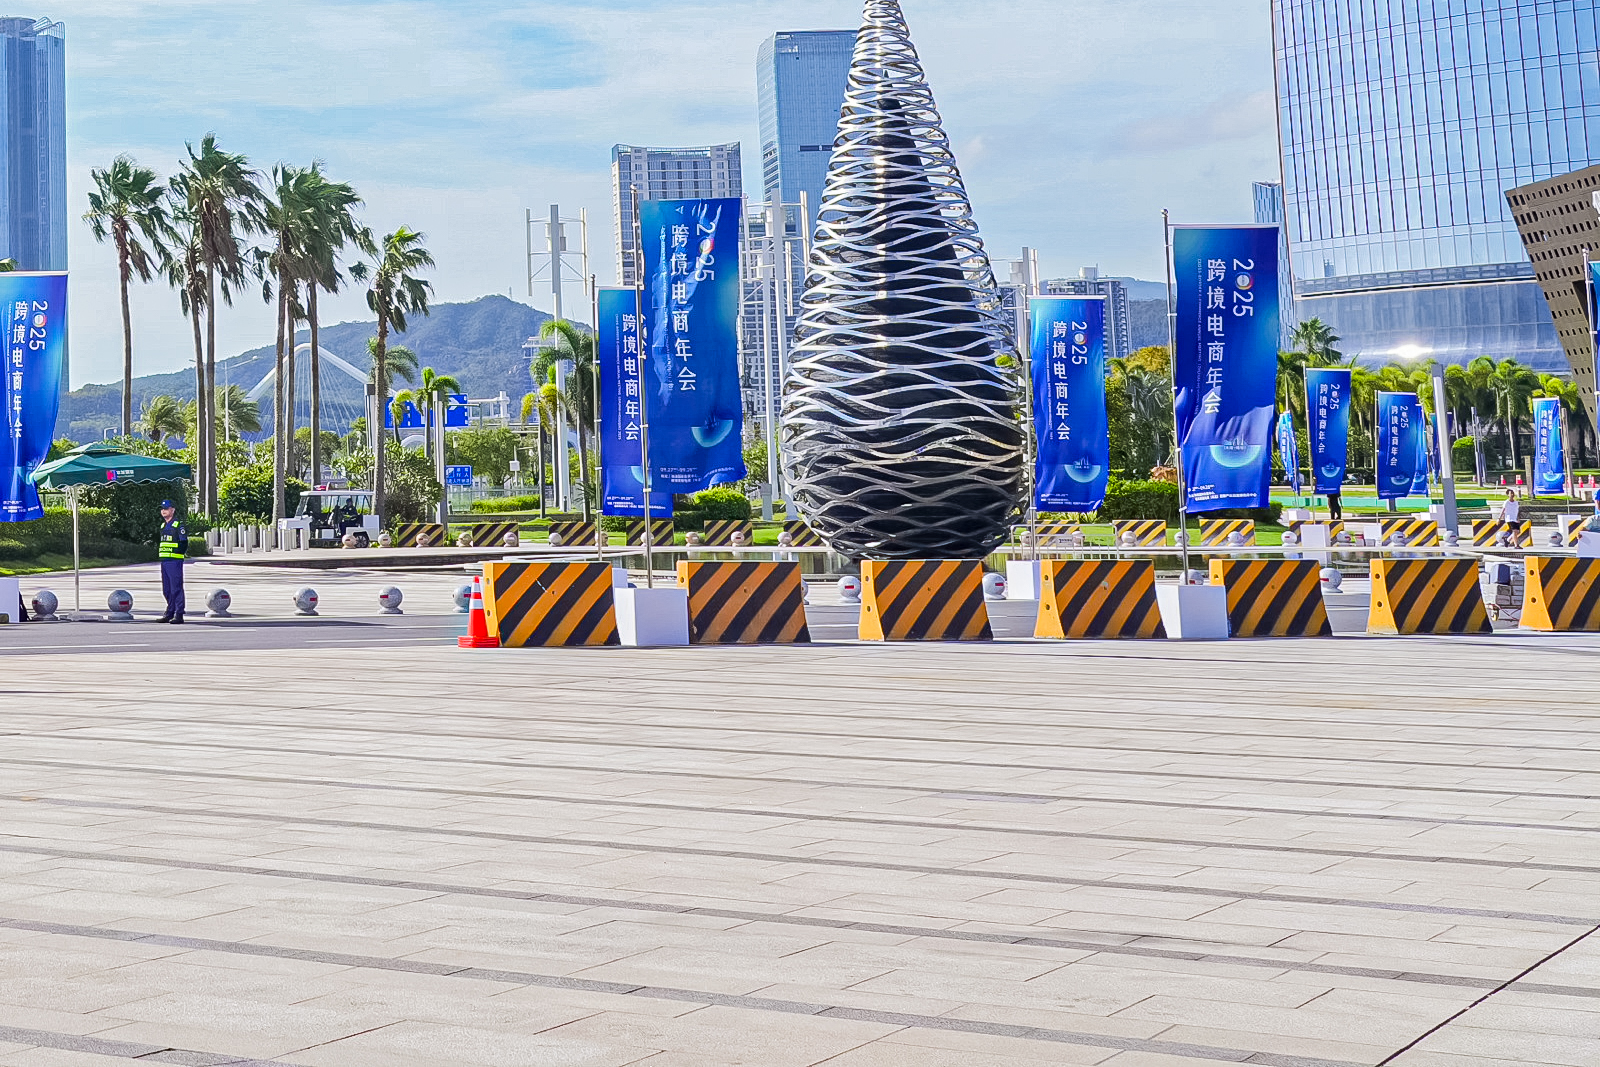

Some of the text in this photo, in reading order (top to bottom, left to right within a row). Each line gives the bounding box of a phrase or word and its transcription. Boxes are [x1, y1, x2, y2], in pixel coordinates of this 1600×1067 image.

[670, 223, 697, 392] 跨境电商年会
[694, 221, 716, 282] 2025
[1232, 258, 1255, 317] 2025
[12, 300, 28, 438] 跨境电商年会
[28, 300, 49, 351] 2025
[622, 313, 640, 441] 跨境电商年会
[1052, 320, 1071, 441] 跨境电商年会
[1071, 321, 1088, 365] 2025
[1204, 258, 1227, 414] 跨境电商年会
